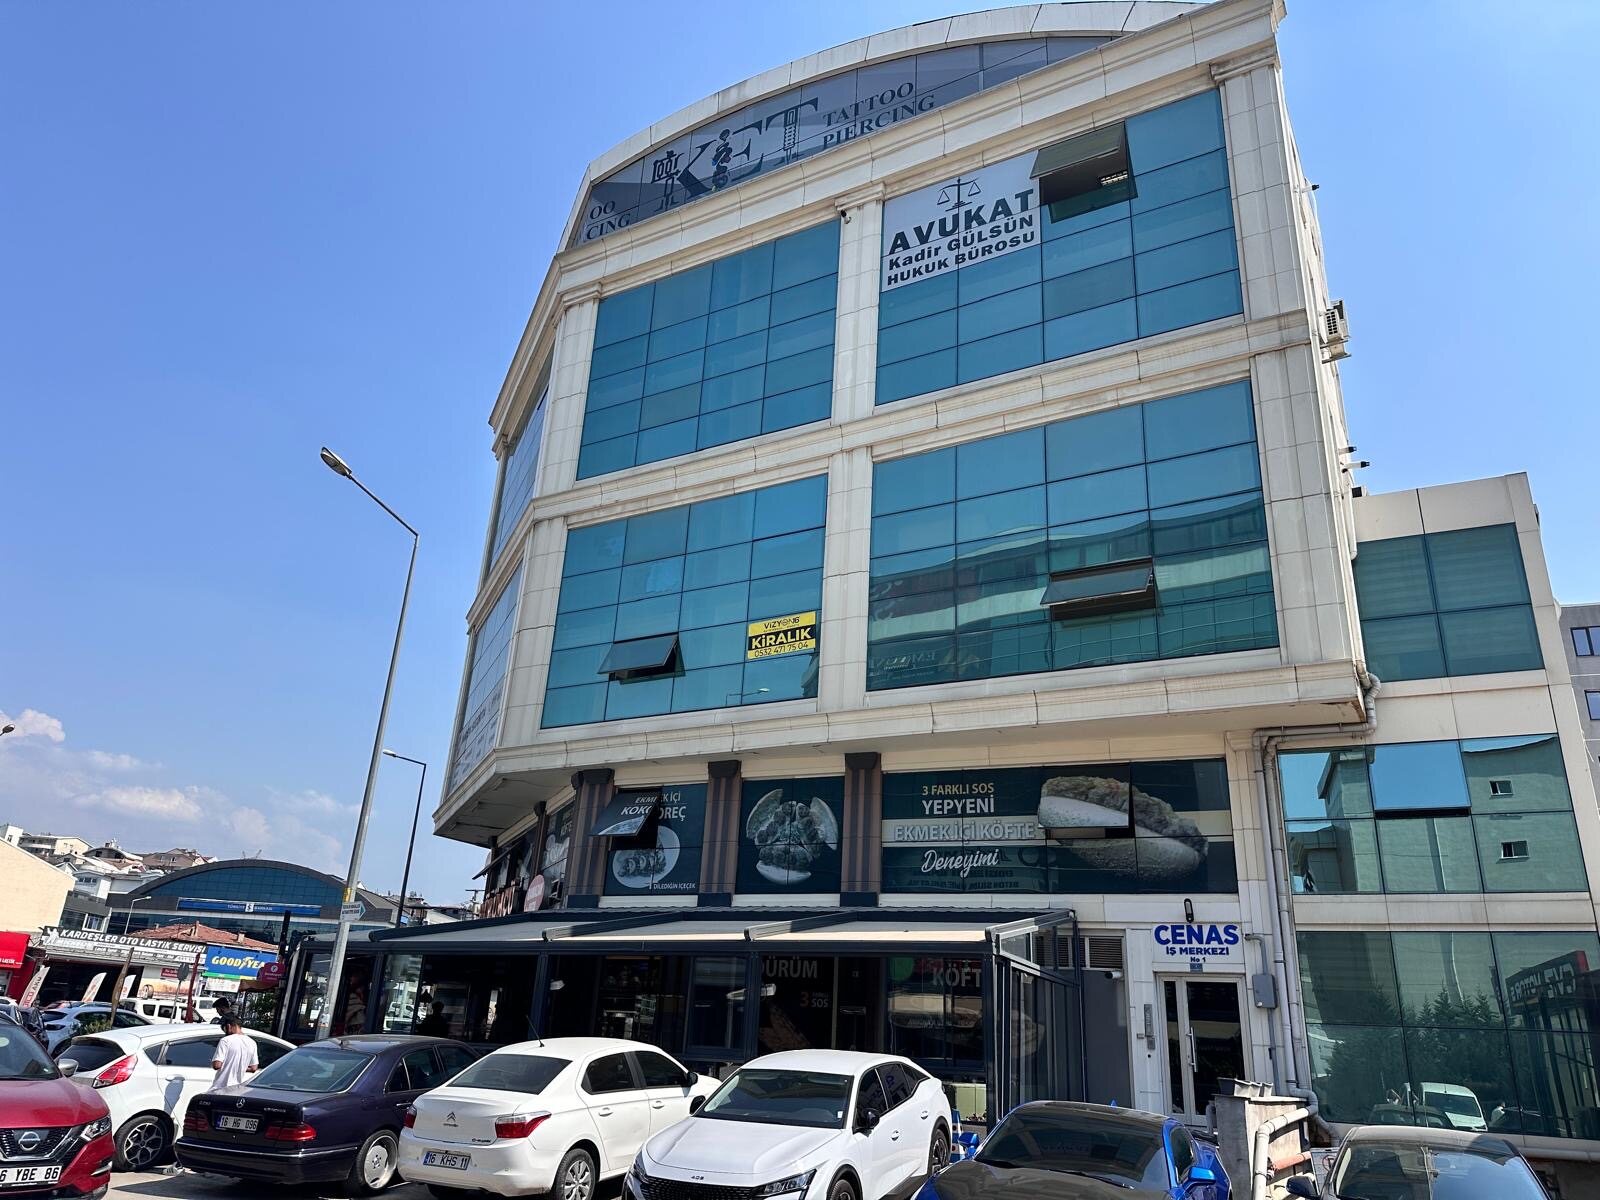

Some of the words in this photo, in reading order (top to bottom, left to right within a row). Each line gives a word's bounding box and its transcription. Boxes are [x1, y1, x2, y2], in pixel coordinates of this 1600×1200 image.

[823, 83, 914, 127] TATTOO
[823, 95, 935, 149] PIERCING
[889, 189, 1034, 256] AVUKAT
[889, 246, 941, 271] Kadir
[947, 214, 1033, 252] GÜLSÜN
[887, 258, 949, 286] HUKUK
[955, 231, 1035, 265] BÜROSU
[755, 648, 772, 658] 0532
[922, 786, 929, 796] 3
[931, 784, 969, 796] FARKLI
[972, 782, 994, 794] SOS
[922, 795, 995, 815] YEPYENİ
[894, 824, 950, 842] EKMEK
[979, 819, 1036, 840] KÖFTE
[921, 848, 1000, 878] Deneyimi
[60, 928, 119, 944] KARDEŞLER
[119, 936, 138, 946] OTO
[1154, 924, 1240, 946] CENAS
[1166, 946, 1176, 956] İŞ
[1179, 946, 1229, 955] MERKEZİ
[211, 955, 265, 970] GOODYEA
[932, 963, 982, 987] KÖFT
[220, 1115, 228, 1126] 16
[428, 1153, 436, 1164] 16
[440, 1154, 458, 1167] KHS
[460, 1157, 468, 1168] 11
[16, 1168, 38, 1181] YBE
[44, 1167, 60, 1180] 86
